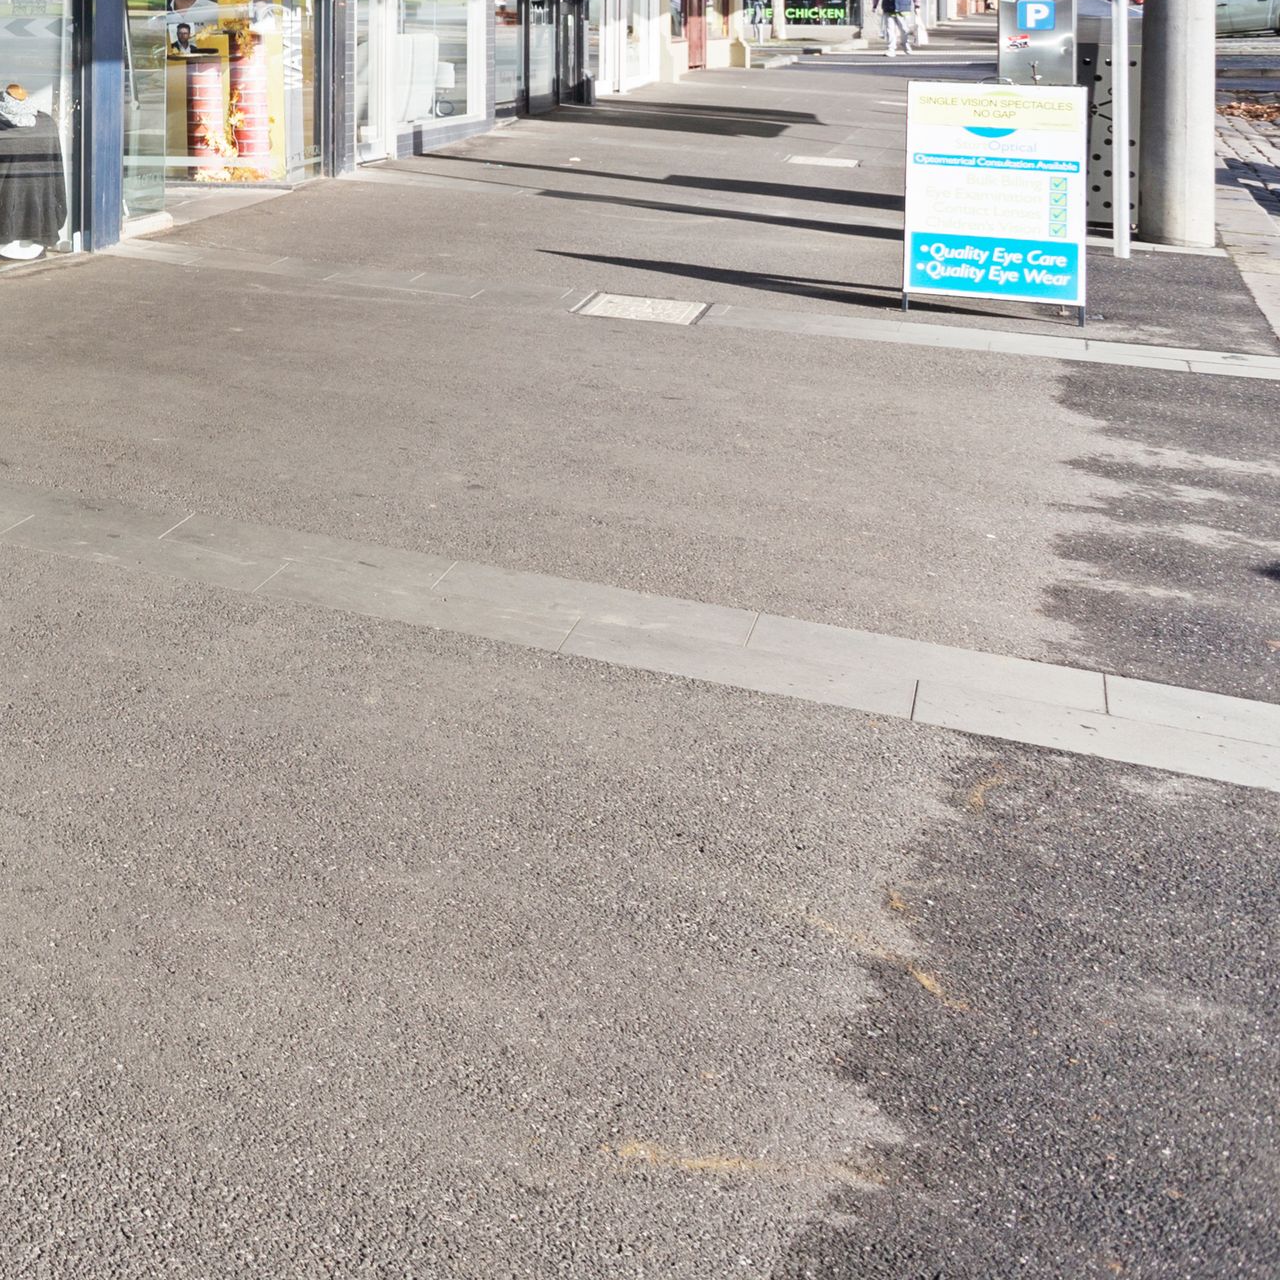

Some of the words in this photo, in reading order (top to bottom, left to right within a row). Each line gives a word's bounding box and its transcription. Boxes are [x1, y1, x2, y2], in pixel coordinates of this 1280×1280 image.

[785, 7, 845, 19] CHICKEN
[1026, 3, 1050, 28] P
[282, 6, 304, 90] WAYNE
[919, 95, 958, 106] SINGLE
[961, 97, 998, 108] VISION
[1000, 98, 1073, 111] SPECTACLES
[973, 109, 990, 118] NO
[992, 110, 1017, 119] GAP
[930, 243, 989, 264] Quality
[992, 247, 1023, 267] Eye
[1026, 250, 1068, 268] Care
[926, 261, 986, 283] Quality
[988, 265, 1019, 285] Eye
[1023, 268, 1071, 286] Wear
